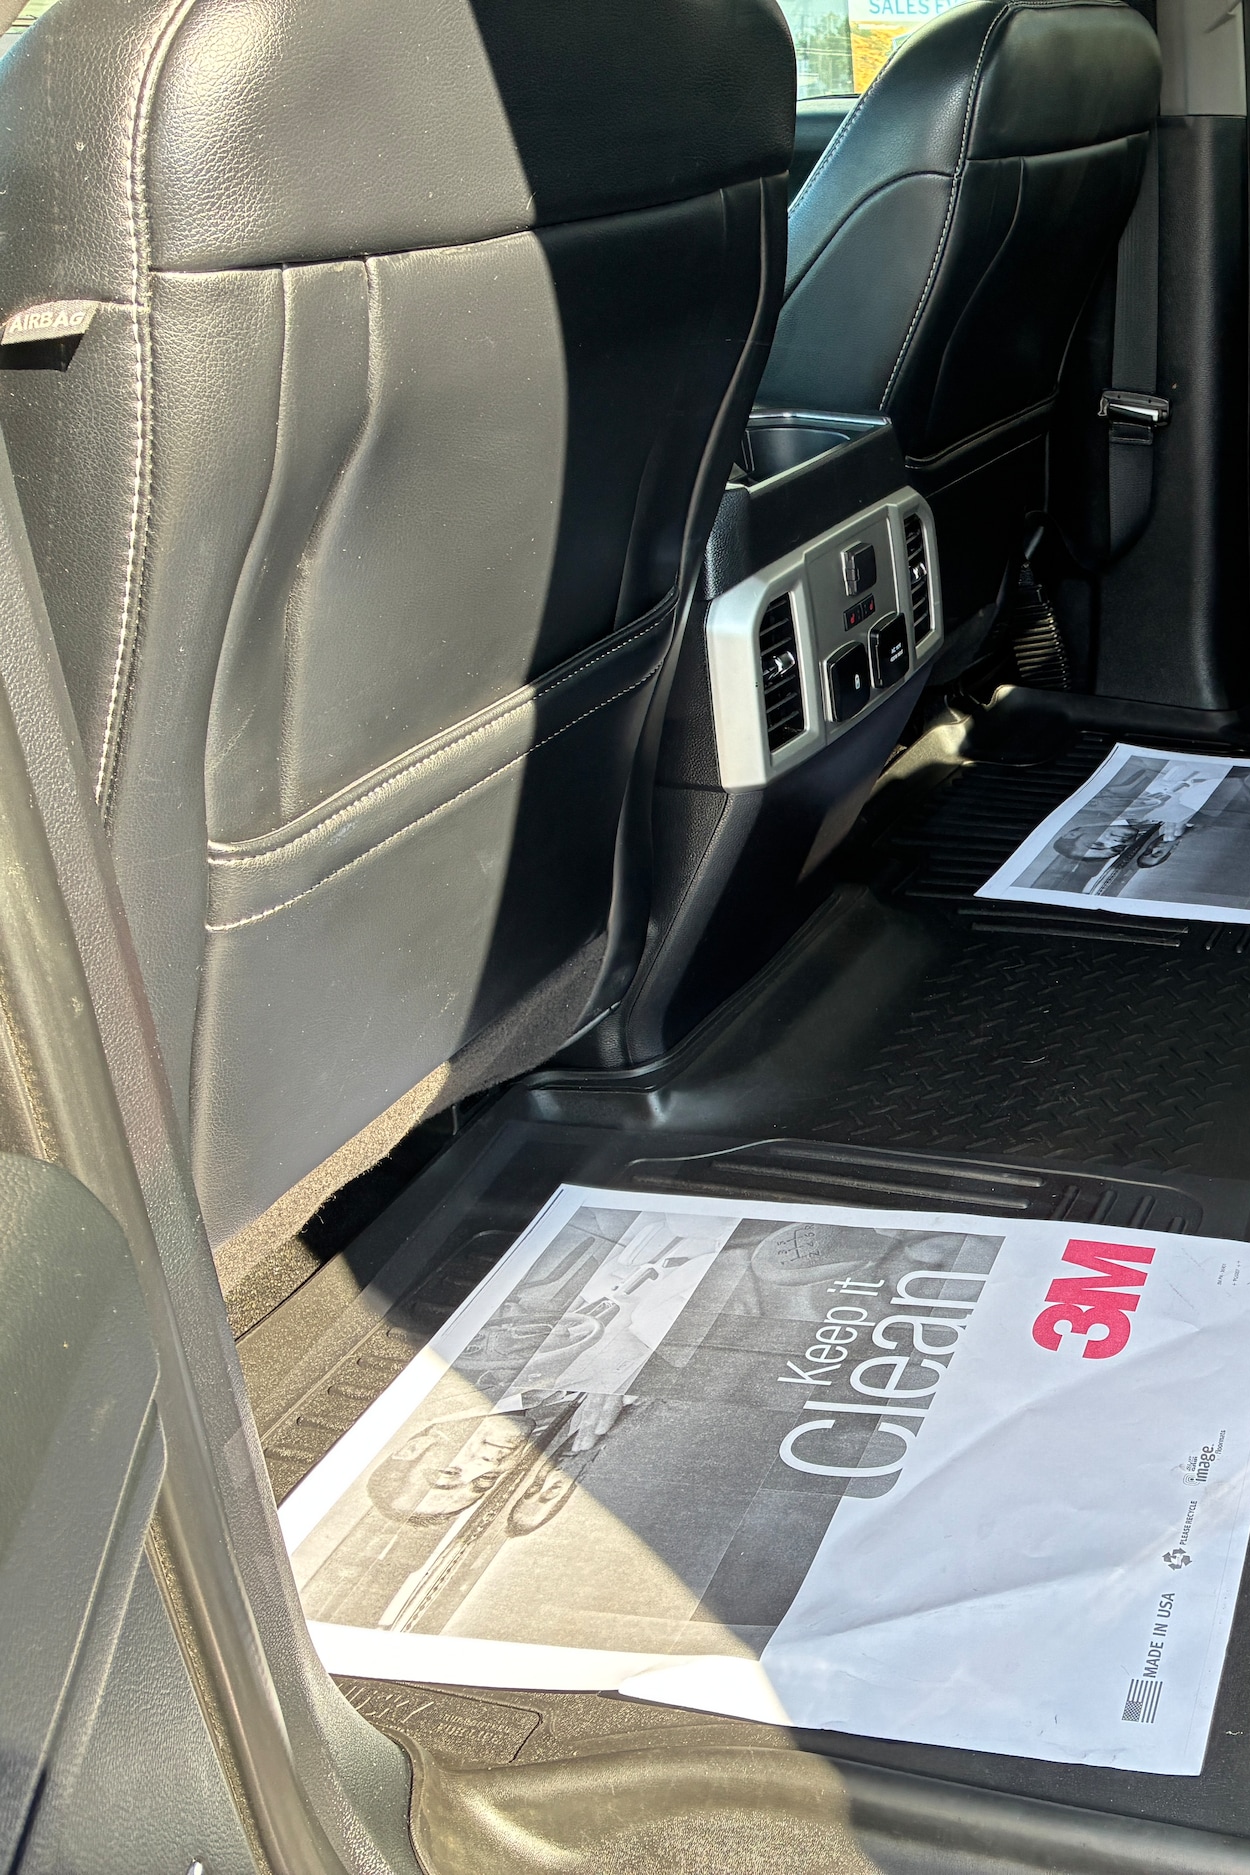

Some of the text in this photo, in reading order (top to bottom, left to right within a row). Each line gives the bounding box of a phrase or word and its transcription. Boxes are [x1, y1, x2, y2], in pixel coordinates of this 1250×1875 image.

[869, 0, 930, 14] SALES
[9, 311, 86, 333] AIRBAG
[777, 1276, 885, 1386] Keep it
[1032, 1239, 1156, 1360] 3M
[779, 1269, 990, 1479] Clean
[1180, 1500, 1198, 1545] PLEASE RECYCLE
[1143, 1593, 1175, 1678] MADE IN USA
